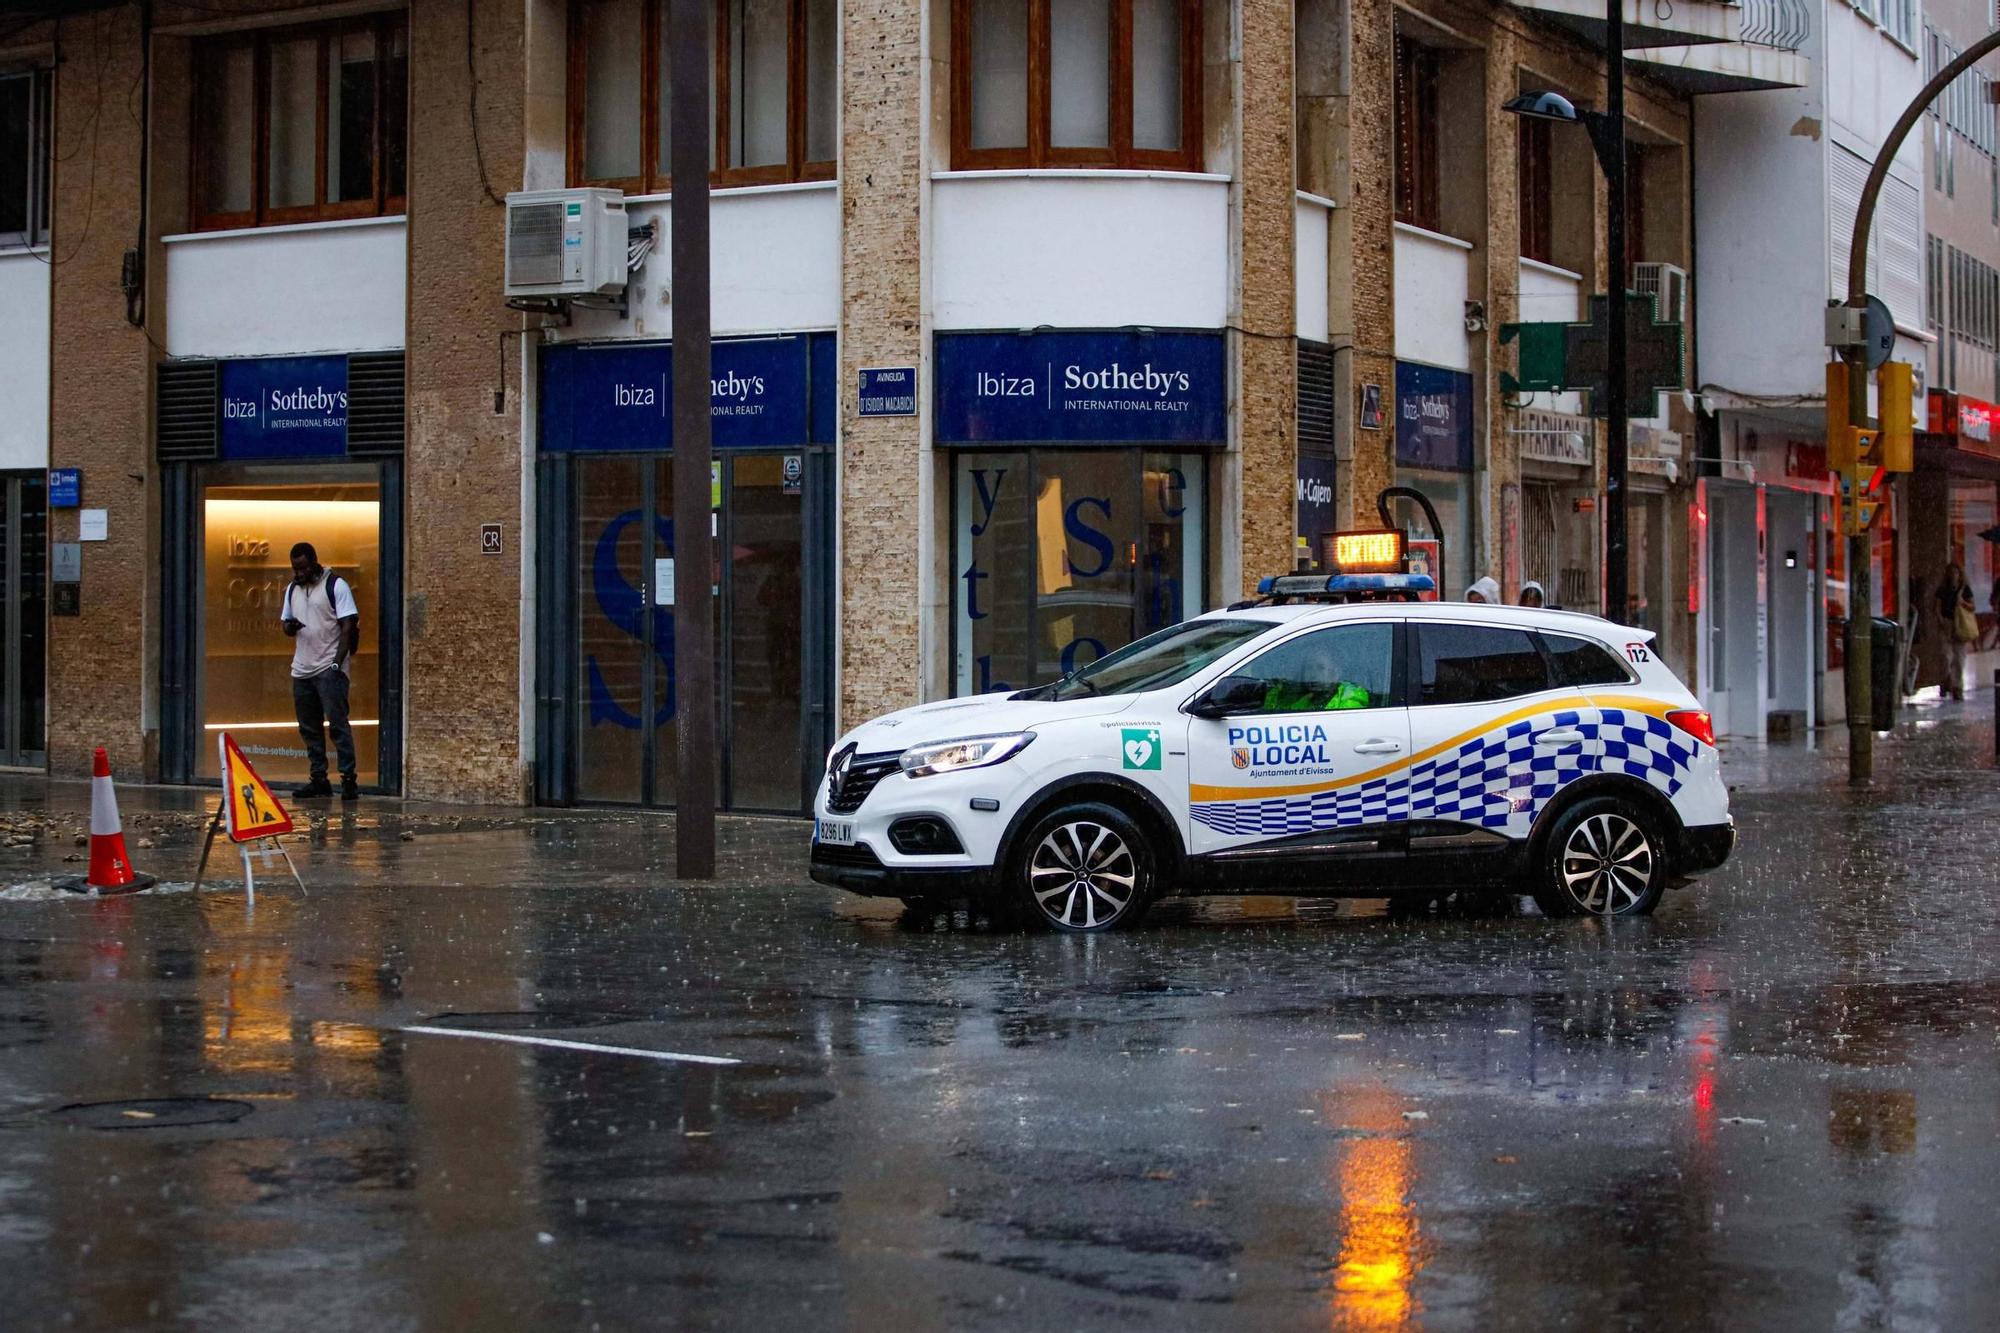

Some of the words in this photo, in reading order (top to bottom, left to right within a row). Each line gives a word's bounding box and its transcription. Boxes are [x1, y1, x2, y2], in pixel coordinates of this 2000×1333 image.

[876, 371, 906, 383] AVINGUDA
[977, 372, 1036, 396] Ibiza
[1064, 363, 1190, 397] Sotheby's
[224, 397, 256, 418] Ibiza
[271, 386, 347, 415] Sotheby's
[614, 383, 655, 406] Ibiza
[735, 405, 764, 415] REALTY
[1064, 400, 1152, 411] INTERNATIONAL
[1154, 401, 1189, 411] REALTY
[271, 419, 322, 429] INTERNATIONAL
[323, 418, 347, 427] REALTY
[483, 531, 500, 547] CR
[1064, 496, 1114, 578] S
[228, 535, 270, 558] Ibiza
[1626, 649, 1650, 663] 112
[1228, 725, 1328, 745] POLICIA
[1252, 745, 1331, 766] LOCAL
[1250, 768, 1298, 779] Ajuntament
[1298, 767, 1334, 776] d'Eivissa
[821, 822, 837, 840] 8296
